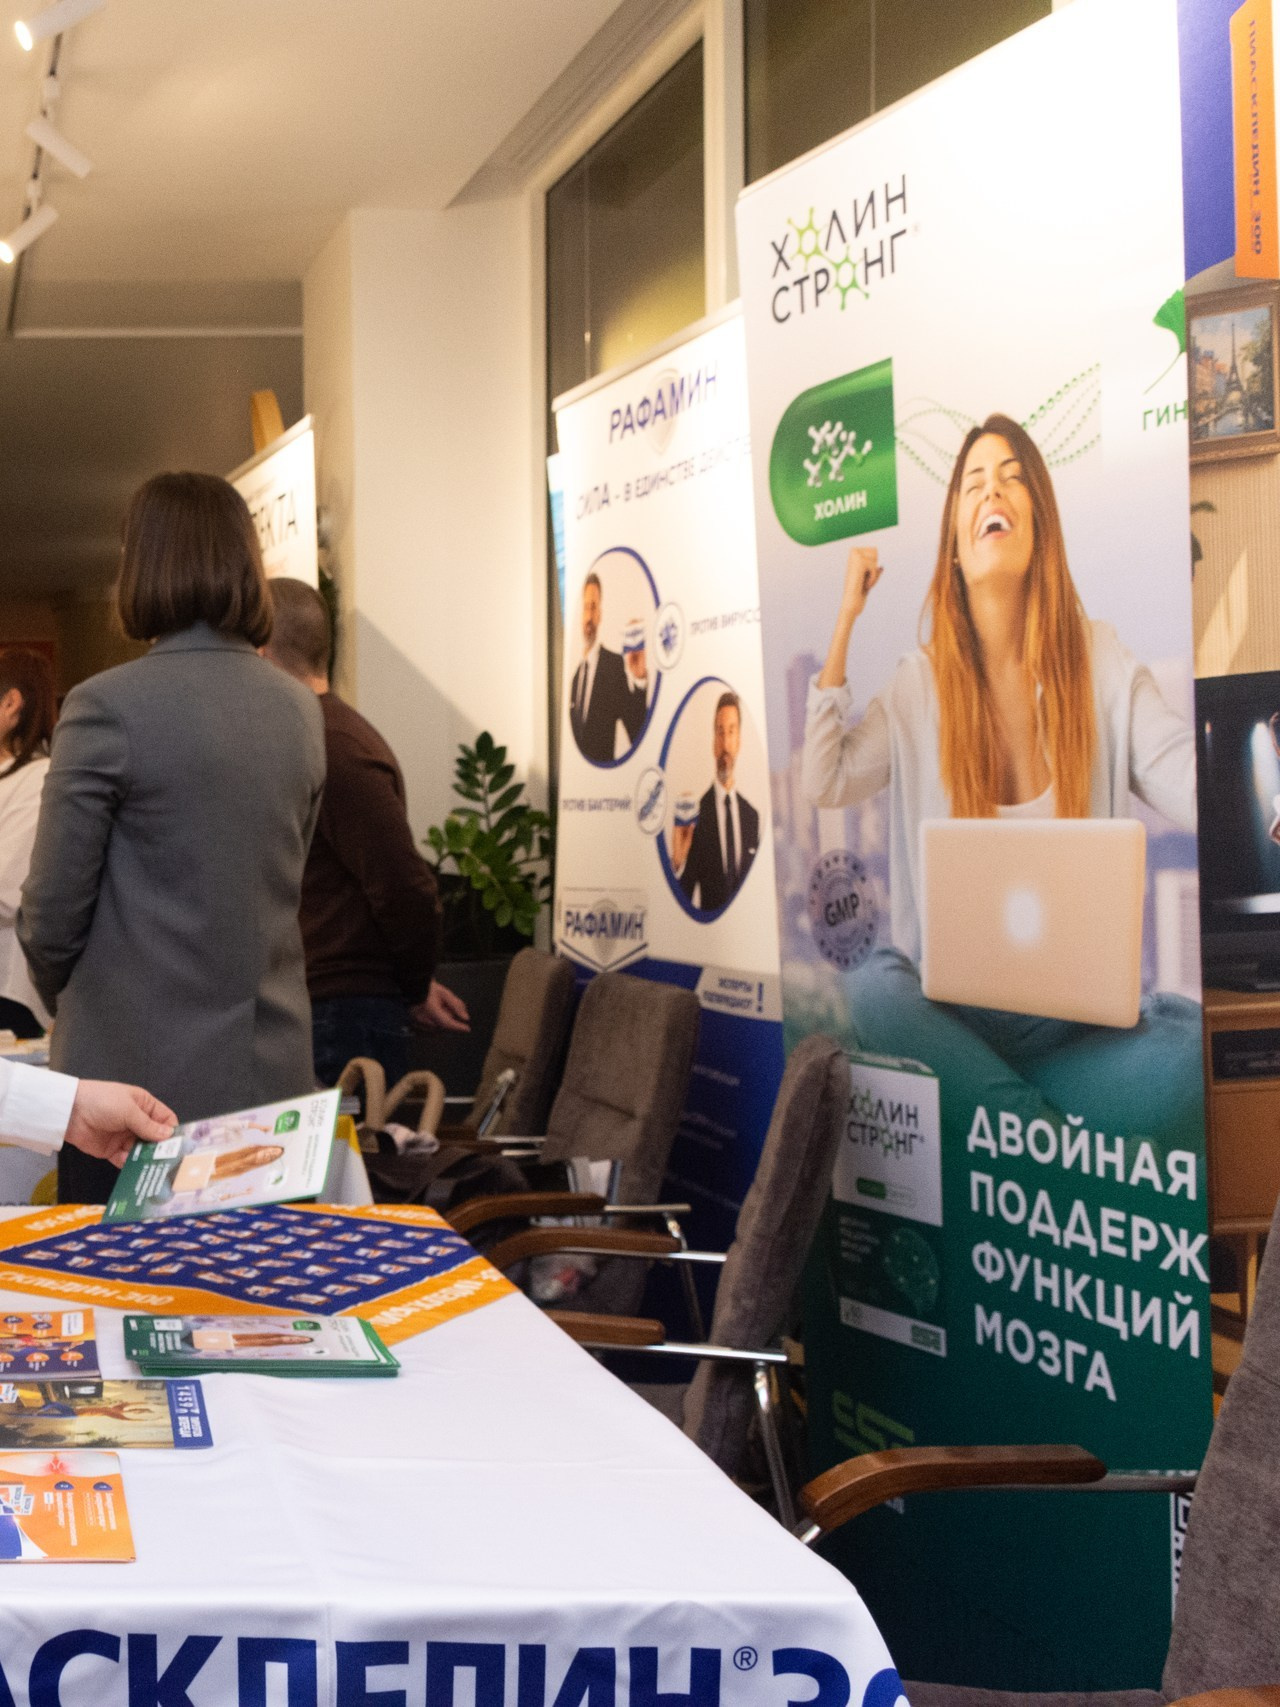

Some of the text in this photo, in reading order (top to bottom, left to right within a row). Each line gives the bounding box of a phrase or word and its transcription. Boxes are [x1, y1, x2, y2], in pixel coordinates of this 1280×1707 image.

[771, 174, 907, 279] ХОЛИН
[772, 229, 907, 323] СТРОНГ
[609, 361, 718, 444] РАФАМИН
[814, 490, 868, 521] ХОЛИН
[566, 910, 646, 940] РАФАМИН
[824, 893, 860, 929] GMP
[847, 1119, 919, 1158] СТРОНГ
[848, 1092, 919, 1130] ХОЛИН
[967, 1105, 1197, 1201] ДВОЙНАЯ
[970, 1171, 1210, 1284] ПОДДЕРЖ
[972, 1241, 1200, 1359] ФУНКЦИЙ
[975, 1303, 1117, 1402] МОЗГА
